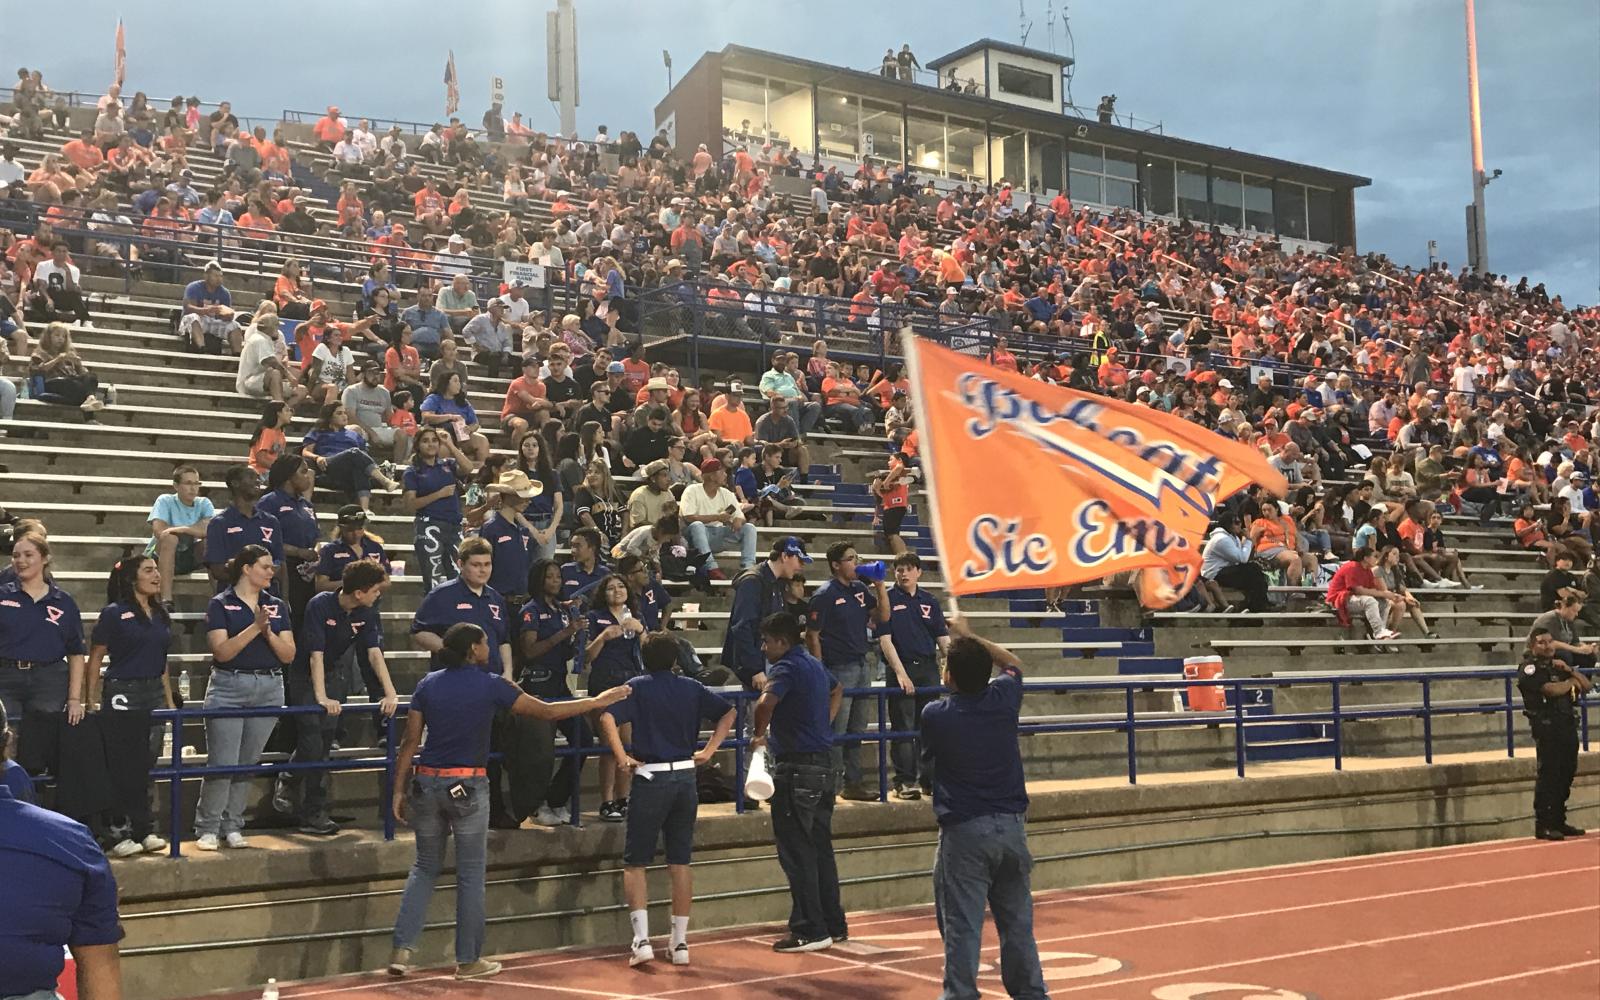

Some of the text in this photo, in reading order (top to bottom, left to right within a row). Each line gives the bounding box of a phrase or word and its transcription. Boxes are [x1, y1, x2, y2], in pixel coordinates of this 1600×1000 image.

[495, 77, 503, 89] B
[866, 134, 872, 144] C
[963, 514, 1055, 582] Sic
[1085, 600, 1091, 612] 5
[1139, 629, 1145, 639] 4
[1256, 689, 1263, 703] 2
